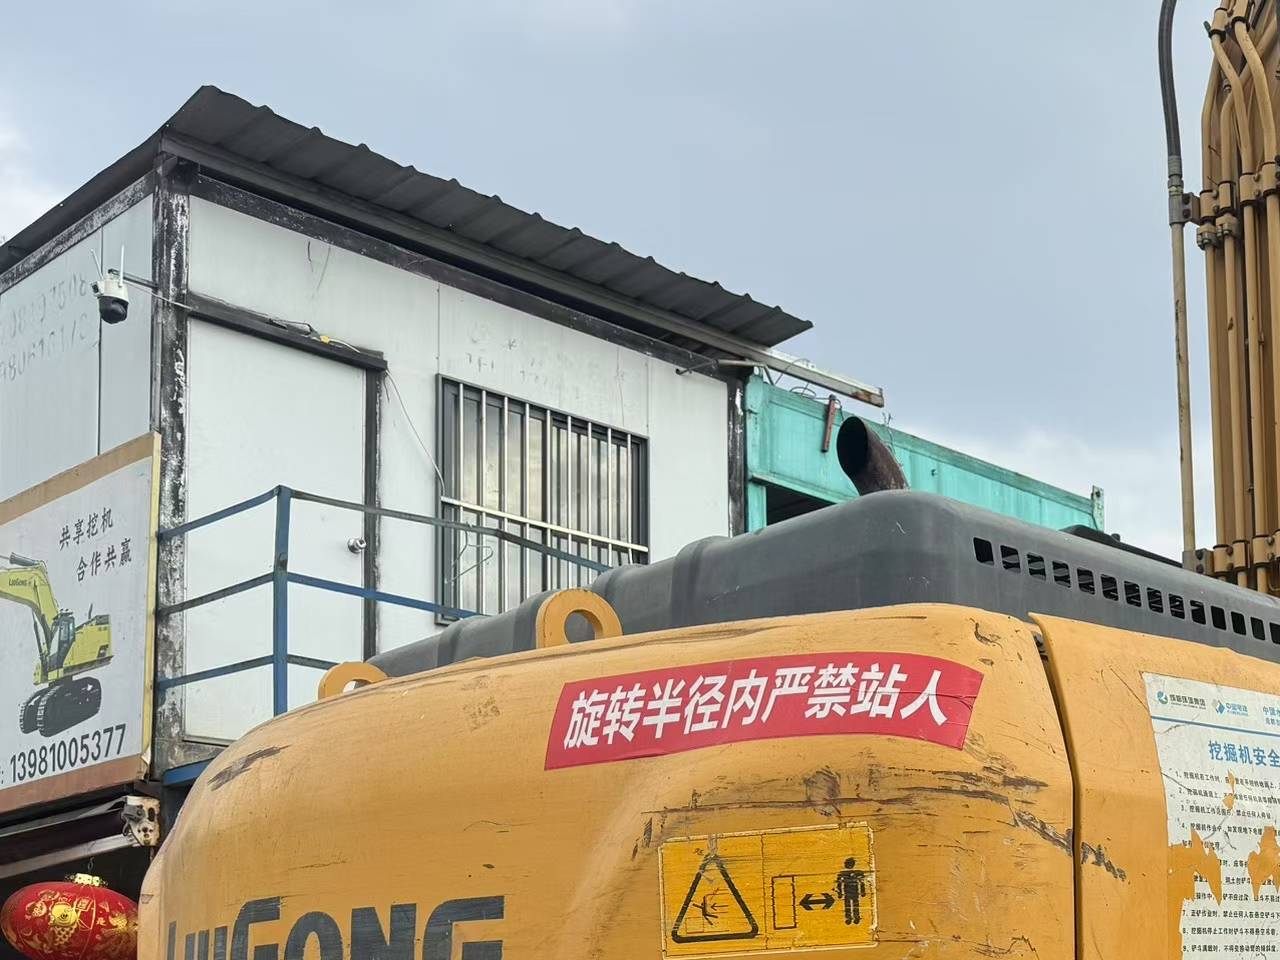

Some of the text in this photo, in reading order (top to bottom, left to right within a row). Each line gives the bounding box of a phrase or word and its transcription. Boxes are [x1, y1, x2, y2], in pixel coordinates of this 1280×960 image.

[59, 507, 113, 551] 共享挖机
[76, 538, 132, 583] 合作共赢
[563, 662, 949, 750] 旋转半径内严禁站人
[10, 723, 127, 783] 13981005377
